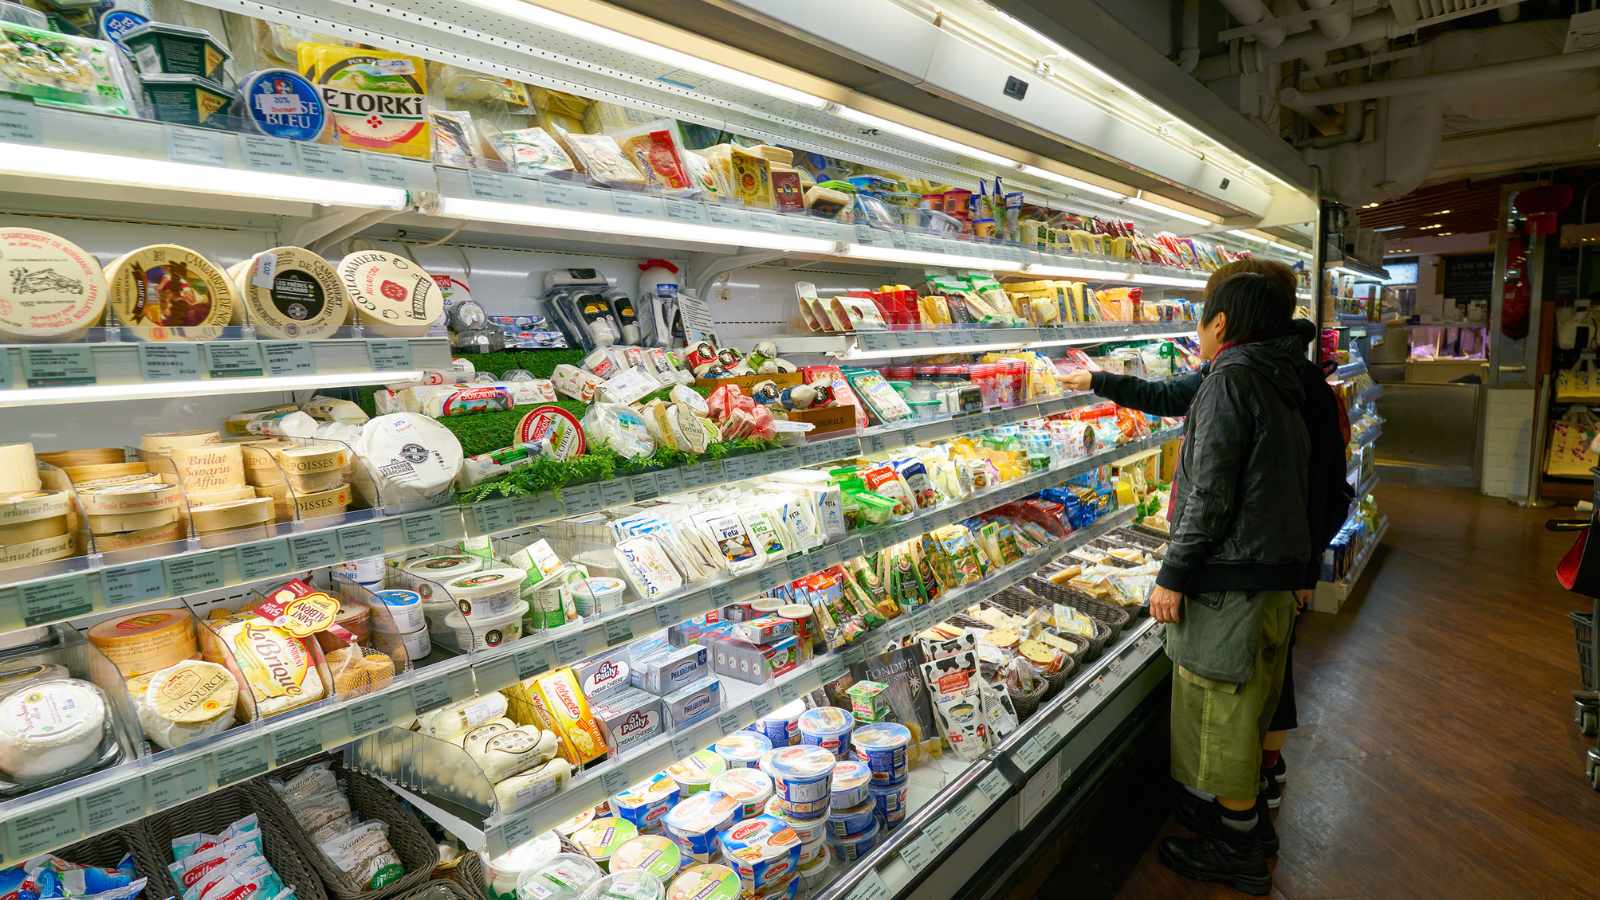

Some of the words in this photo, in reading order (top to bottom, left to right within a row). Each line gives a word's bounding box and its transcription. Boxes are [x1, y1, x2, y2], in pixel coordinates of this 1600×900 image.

[265, 113, 311, 129] BLEU
[343, 253, 387, 311] COULOMMIERS
[722, 528, 740, 539] Feta
[290, 610, 313, 628] SAINT
[293, 602, 329, 622] ALBRAY
[245, 622, 272, 641] La
[255, 638, 304, 698] Brique
[168, 671, 227, 720] CHAOURCE
